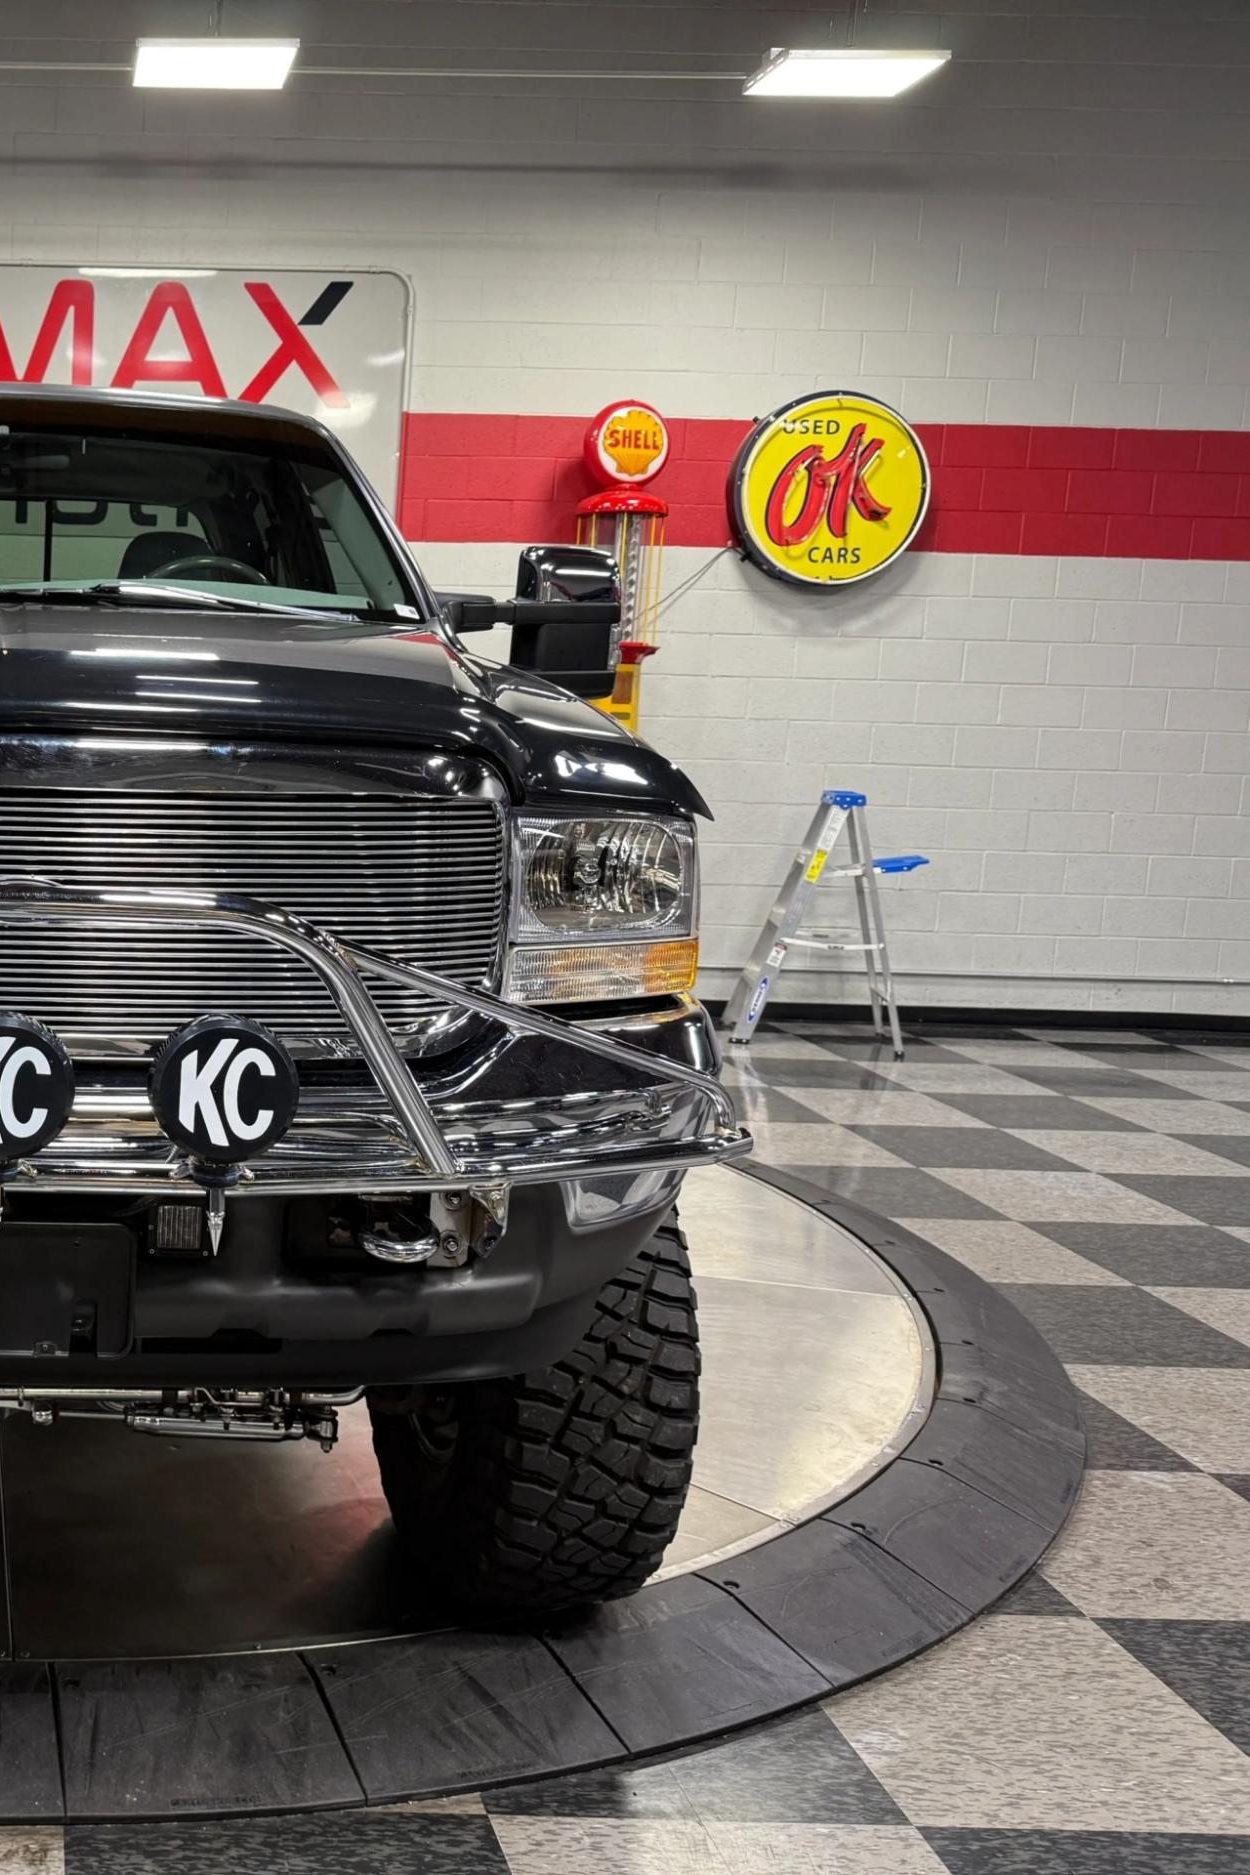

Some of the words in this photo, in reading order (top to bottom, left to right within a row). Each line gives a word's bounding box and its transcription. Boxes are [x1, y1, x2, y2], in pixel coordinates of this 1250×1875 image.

[608, 426, 661, 452] SHELL
[782, 419, 841, 436] USED
[807, 545, 862, 565] CARS
[178, 1038, 275, 1147] KC
